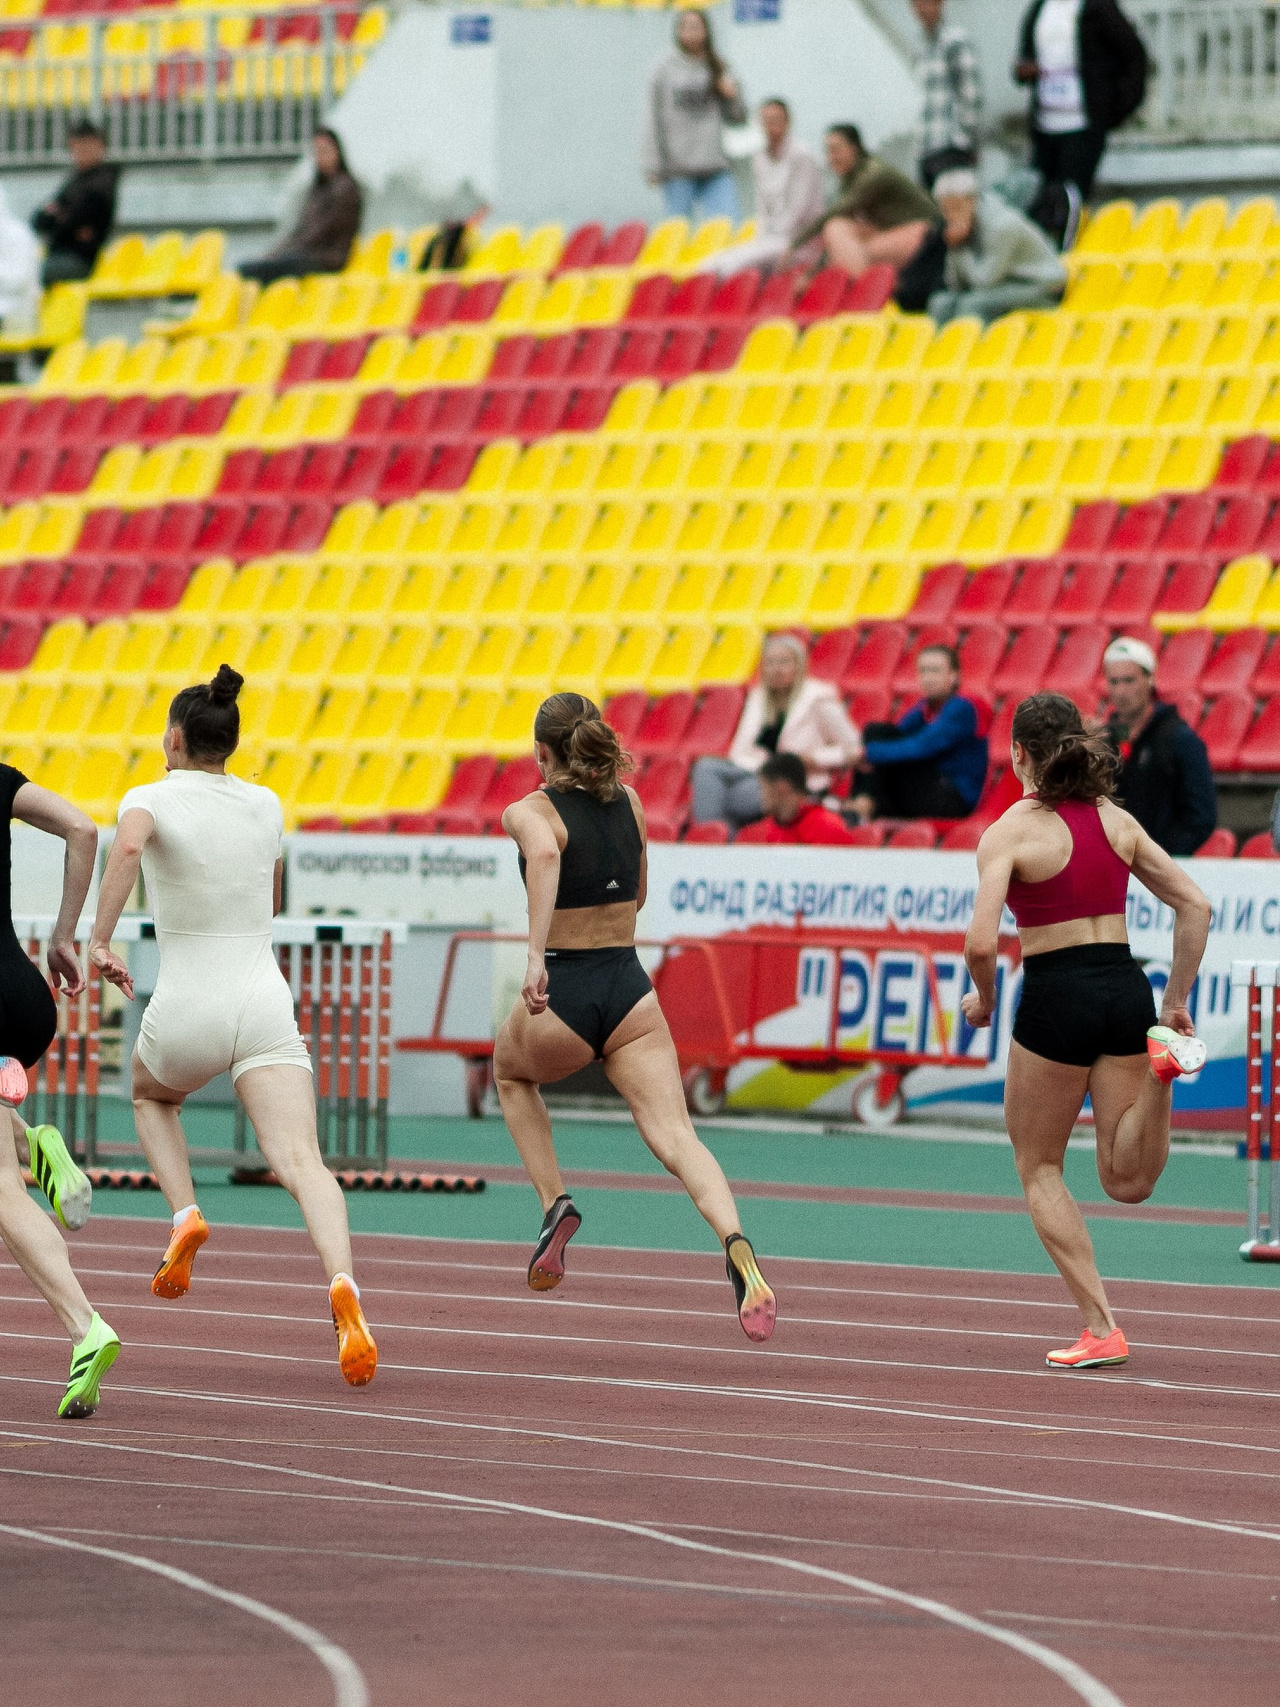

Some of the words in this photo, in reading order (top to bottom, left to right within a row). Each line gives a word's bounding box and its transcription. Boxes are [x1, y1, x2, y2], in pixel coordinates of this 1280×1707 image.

[419, 846, 497, 884] фабрика
[671, 879, 746, 918] ФОНД
[753, 881, 887, 919] РАЗВИТИЯ
